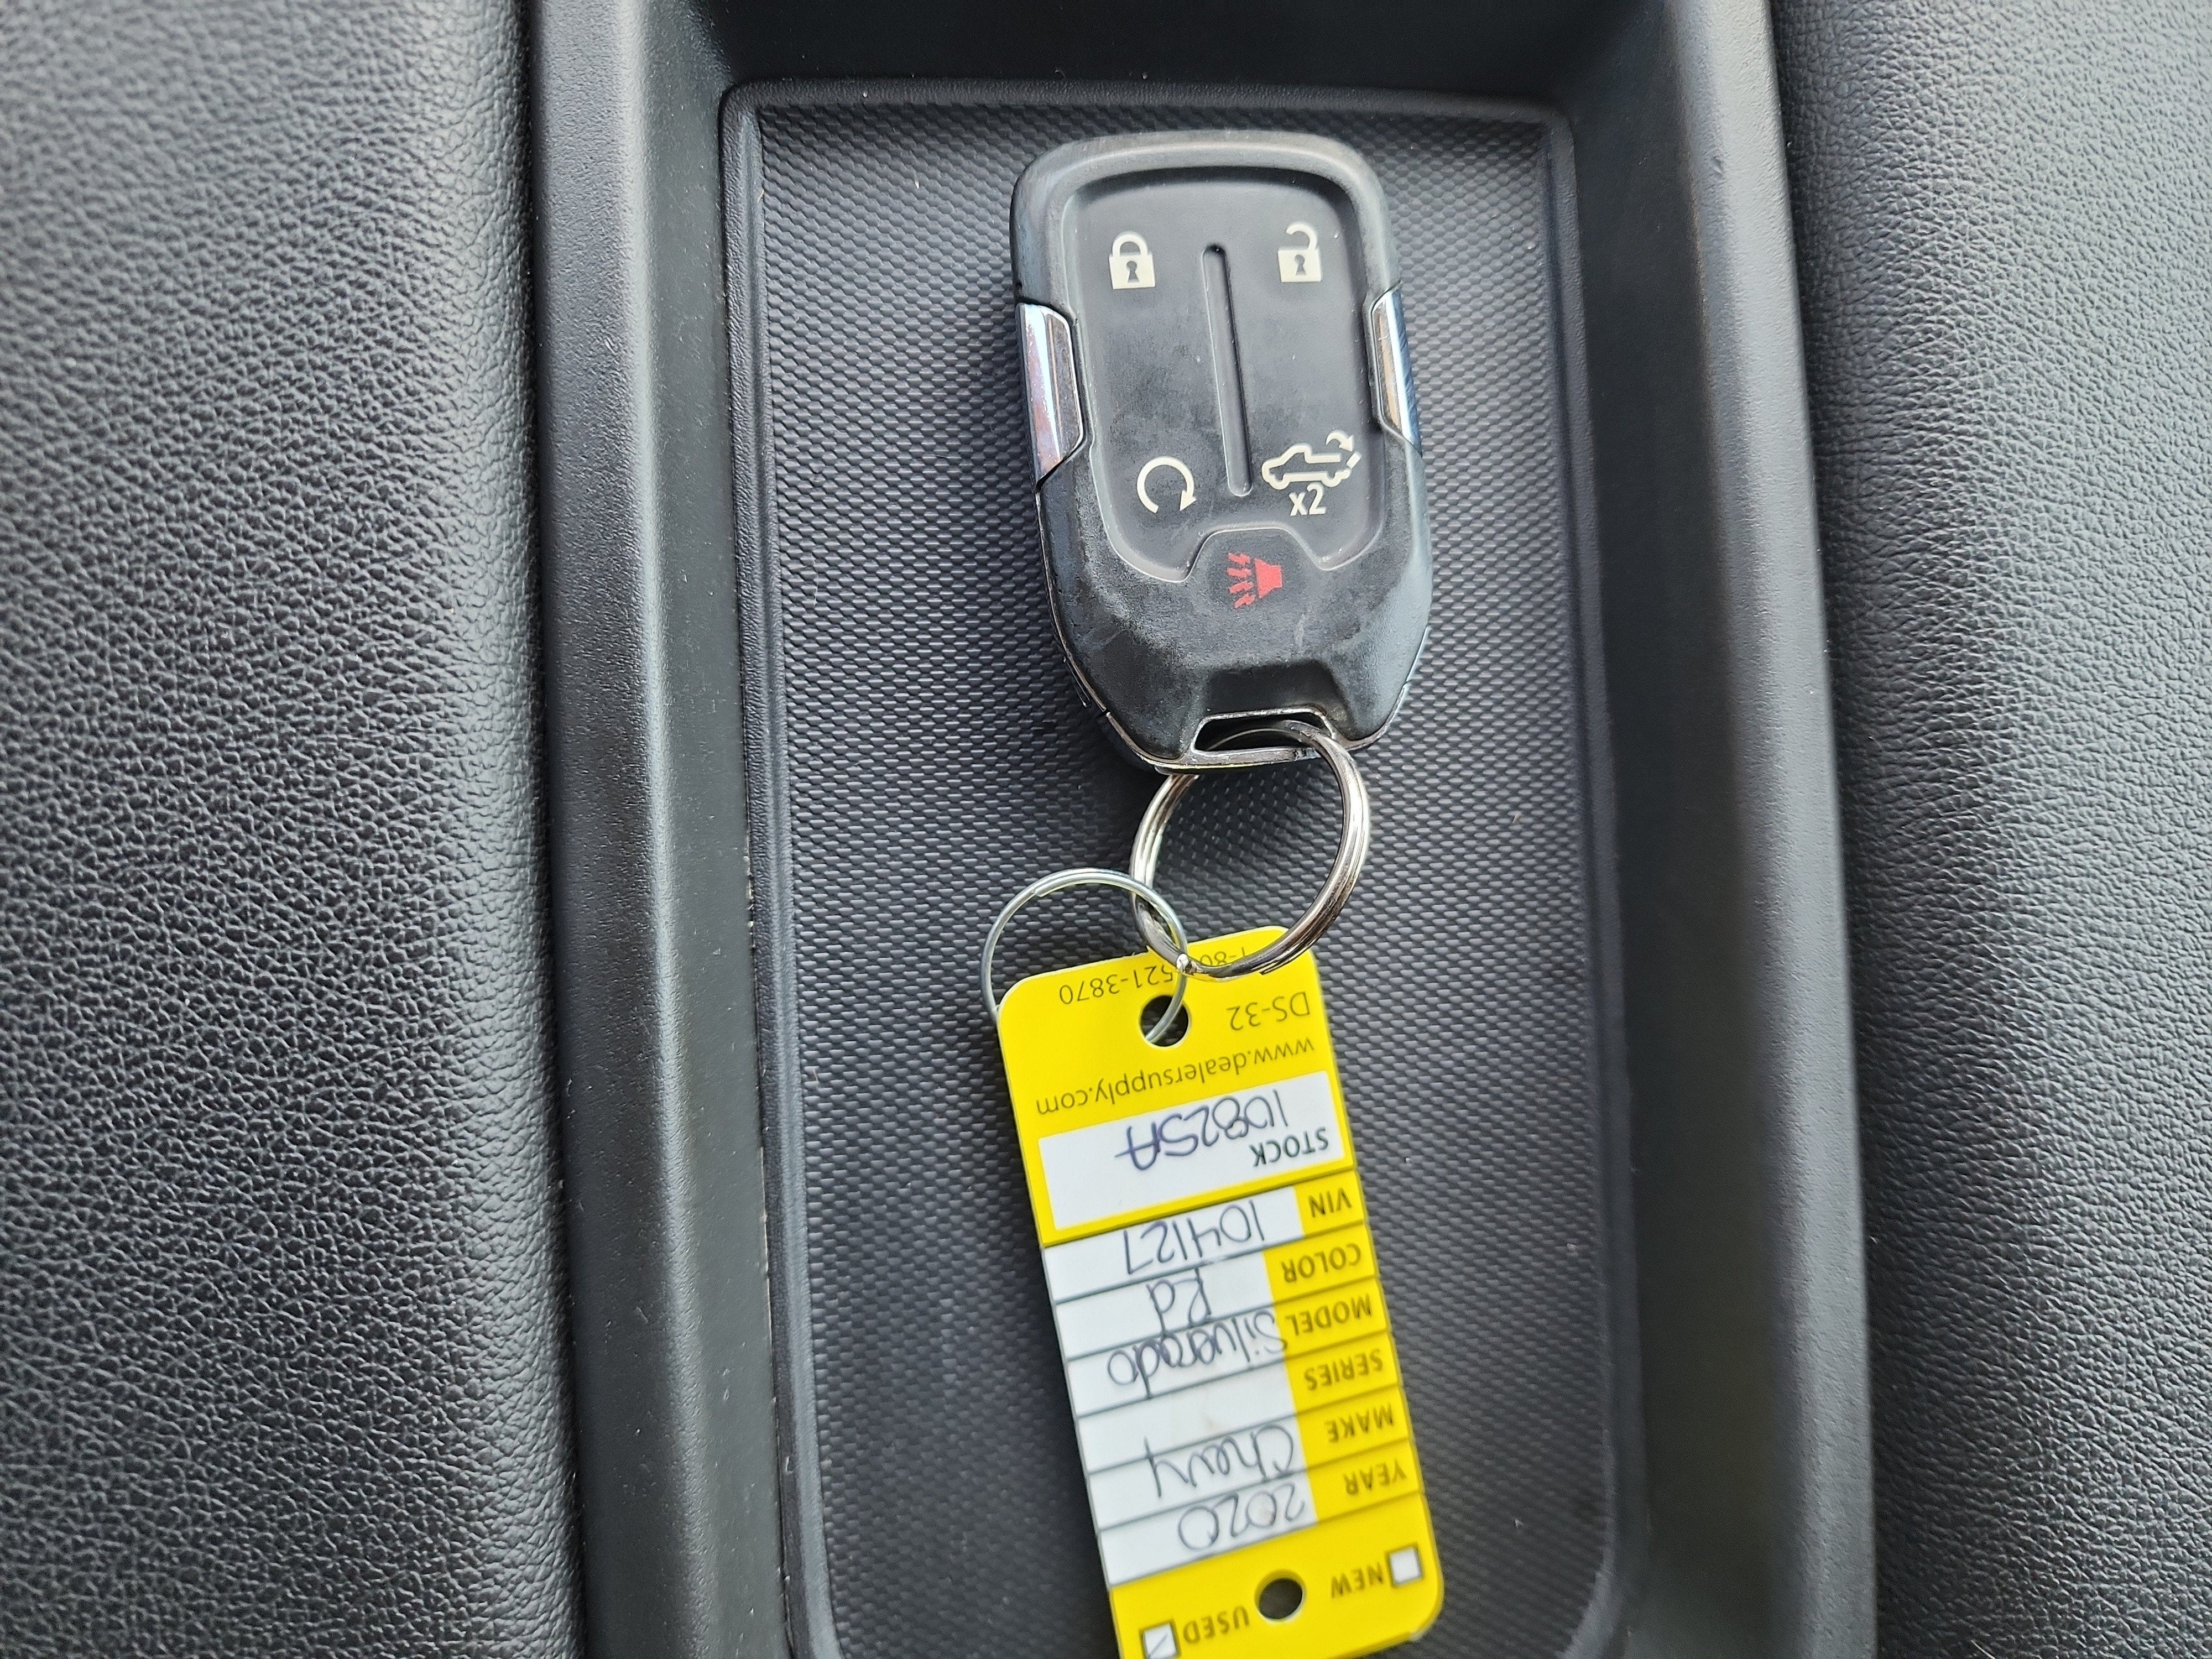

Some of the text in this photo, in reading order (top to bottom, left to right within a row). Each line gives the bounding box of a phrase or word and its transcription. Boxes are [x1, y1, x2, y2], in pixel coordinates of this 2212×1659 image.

[1288, 482, 1327, 516] x2
[1226, 990, 1311, 1031] DS-32
[1035, 1037, 1315, 1117] www.dealersupply.com
[1248, 1126, 1329, 1168] STOCK
[1307, 1187, 1352, 1218] VIN
[1123, 1199, 1265, 1275] 104127
[1280, 1243, 1361, 1285] COLOR
[1284, 1292, 1372, 1336] MODEL
[1107, 1311, 1287, 1399] Silverado
[1303, 1348, 1383, 1392] SERIES
[1324, 1402, 1395, 1444] MAKE
[1143, 1424, 1294, 1498] Chevy
[1343, 1458, 1407, 1497] YEAR
[1178, 1483, 1306, 1552] 2020
[1331, 1562, 1385, 1599] NEW
[1182, 1605, 1250, 1646] USED
